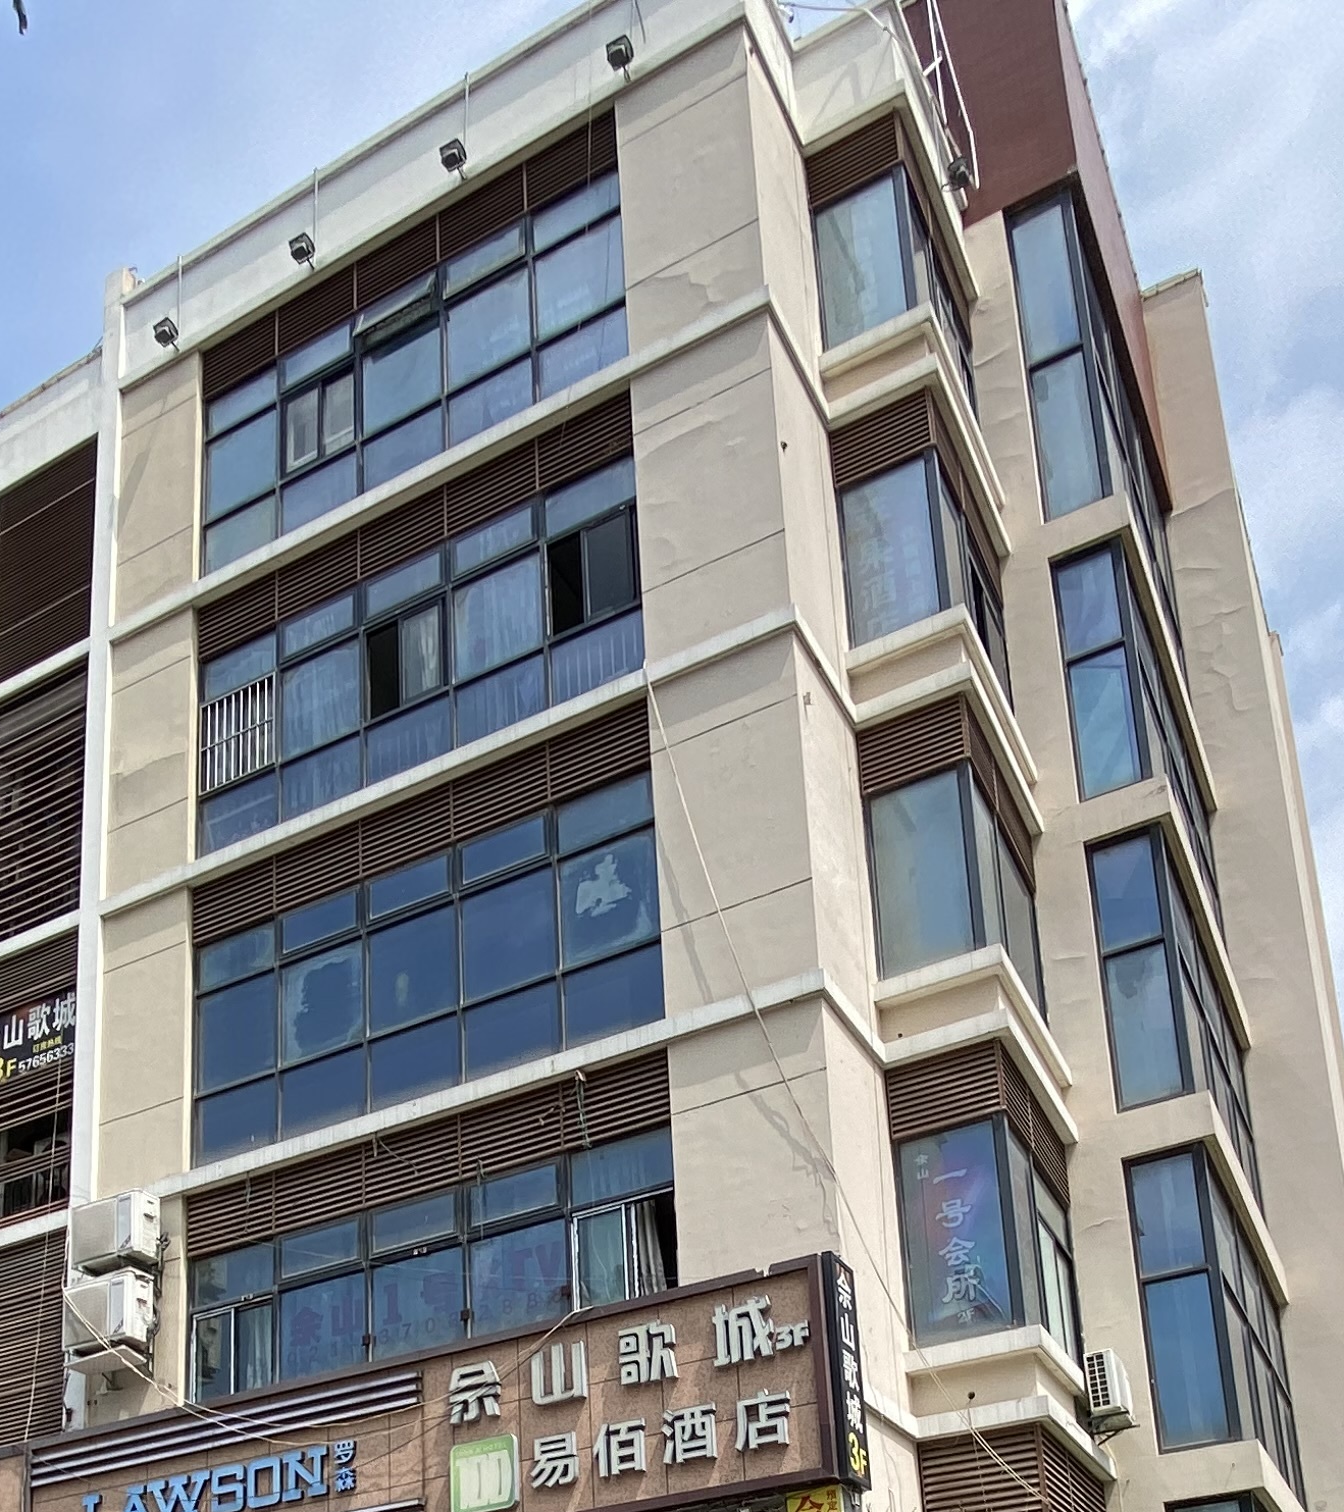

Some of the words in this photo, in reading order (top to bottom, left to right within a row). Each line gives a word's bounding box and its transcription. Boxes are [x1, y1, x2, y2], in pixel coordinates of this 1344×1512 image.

[18, 1042, 74, 1073] 57656333
[932, 1168, 981, 1304] 一号会所
[449, 1294, 774, 1426] 佘山歌城
[836, 1270, 864, 1434] 佘山歌城
[333, 1440, 356, 1492] 罗森
[530, 1389, 792, 1491] 易佰酒店
[847, 1431, 869, 1476] 3F
